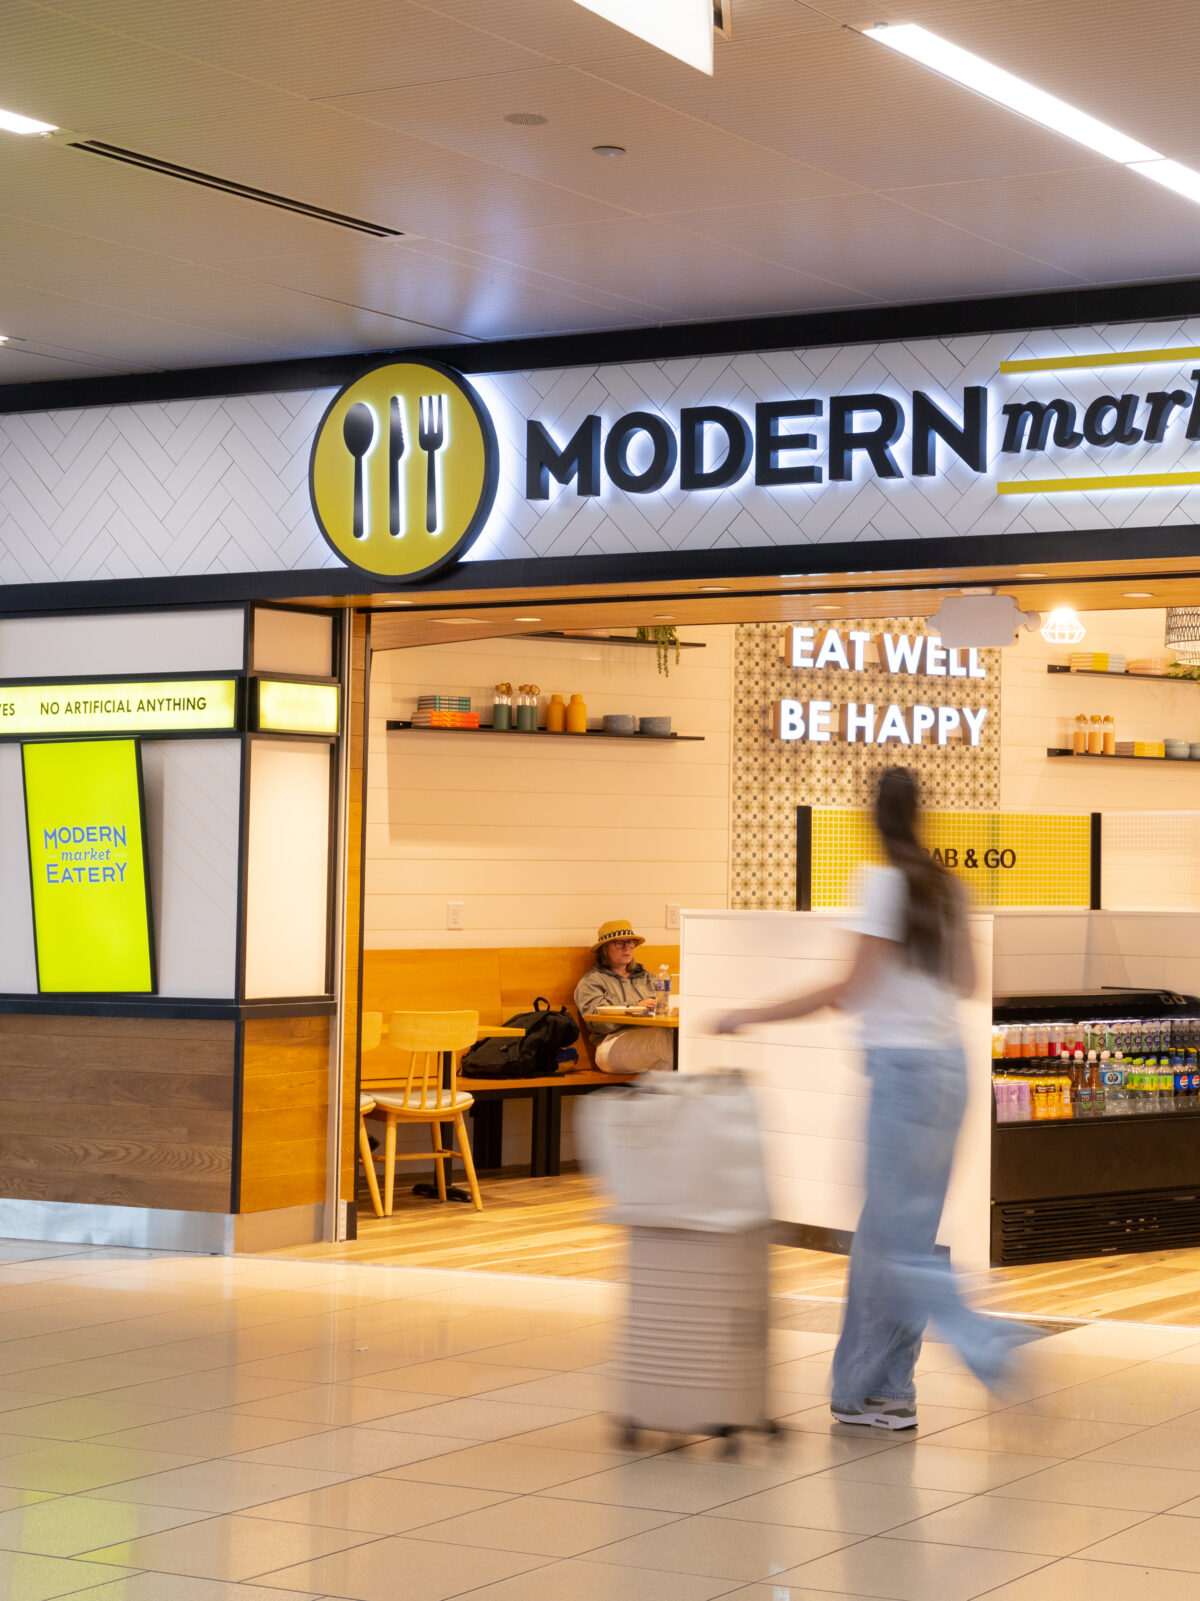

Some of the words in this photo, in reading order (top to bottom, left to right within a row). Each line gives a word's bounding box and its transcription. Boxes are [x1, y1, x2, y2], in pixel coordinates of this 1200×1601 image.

[526, 385, 987, 501] MODERN
[790, 626, 871, 671] EAT
[882, 633, 987, 679] WELL
[40, 702, 60, 716] NO
[64, 699, 132, 715] ARTIFICIAL
[136, 696, 207, 713] ANYTHING
[779, 699, 831, 742] BE
[846, 702, 988, 746] HAPPY
[43, 825, 127, 850] MODERN
[61, 847, 111, 862] market
[964, 848, 979, 869] &
[984, 848, 1017, 869] GO
[46, 862, 128, 883] EATERY
